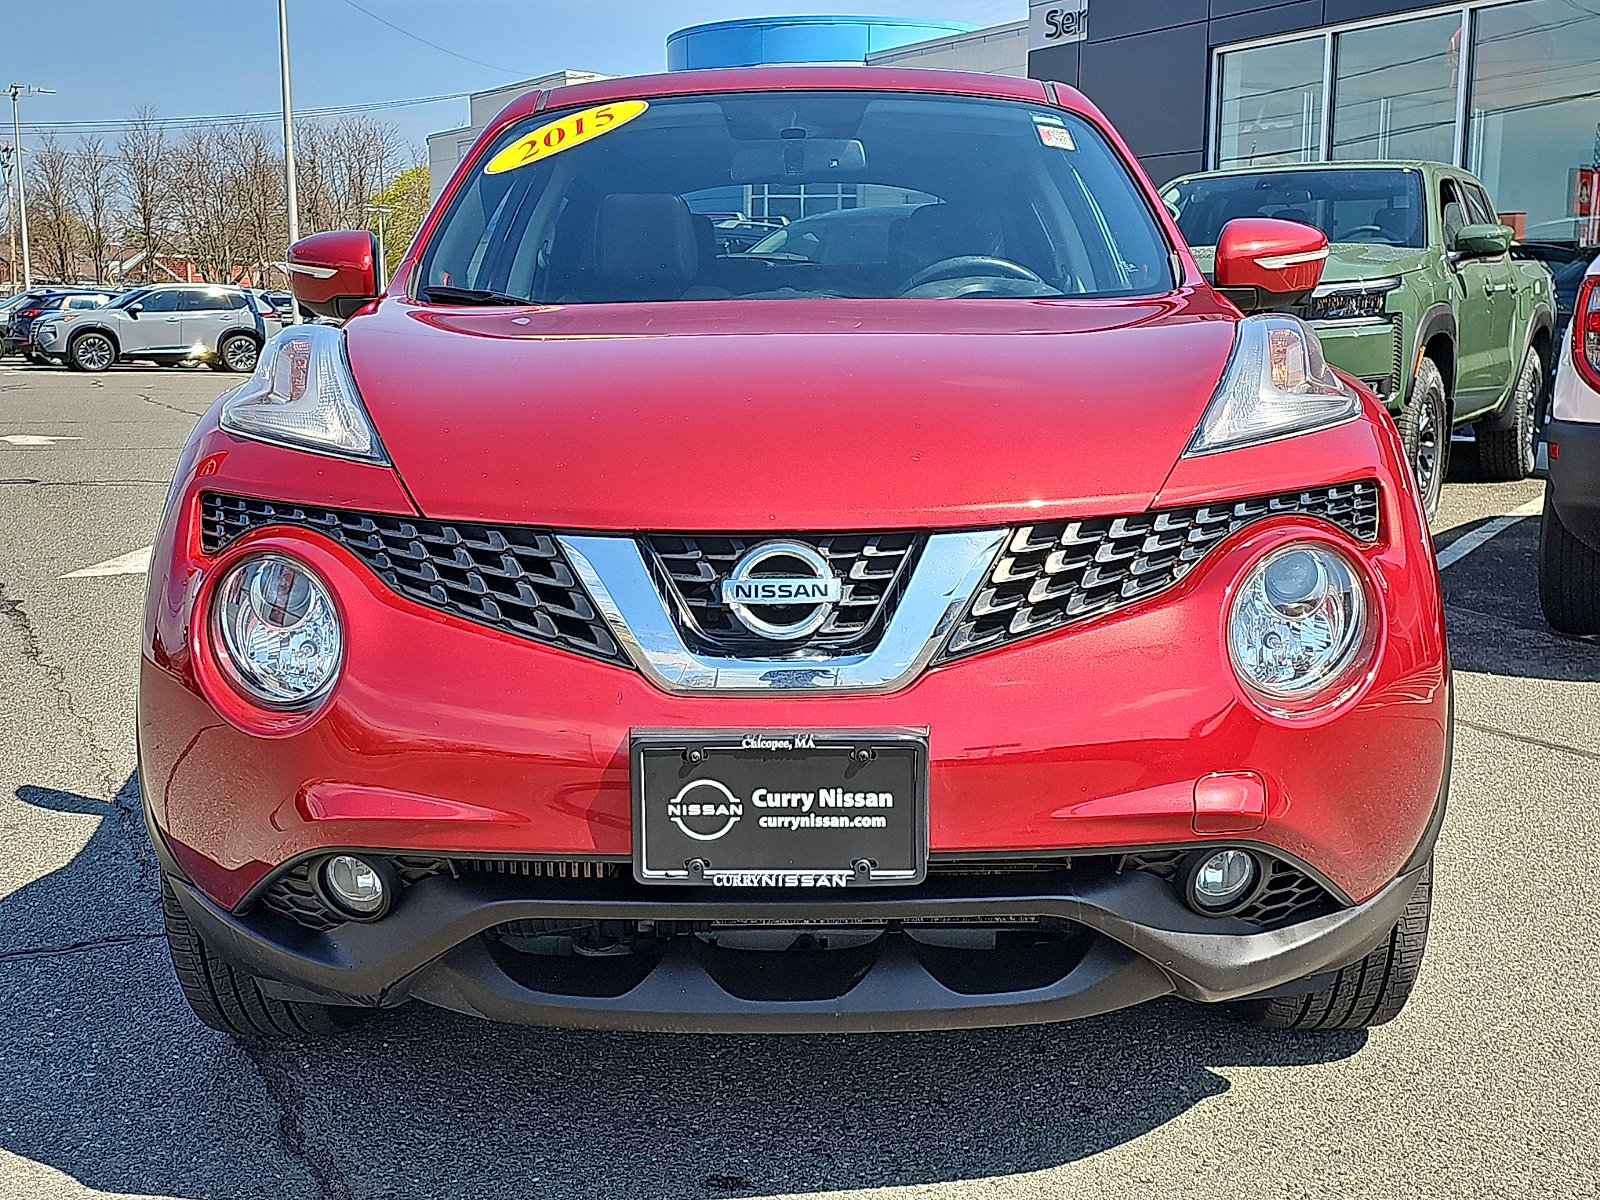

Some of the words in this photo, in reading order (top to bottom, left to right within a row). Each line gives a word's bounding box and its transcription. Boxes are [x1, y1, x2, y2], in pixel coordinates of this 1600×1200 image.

[518, 106, 615, 162] 2015
[735, 584, 829, 599] NISSAN
[794, 738, 816, 749] MA
[751, 788, 814, 811] Curry
[819, 788, 893, 808] Nissan
[668, 804, 743, 816] NISSAN
[758, 813, 887, 829] currynissan.com
